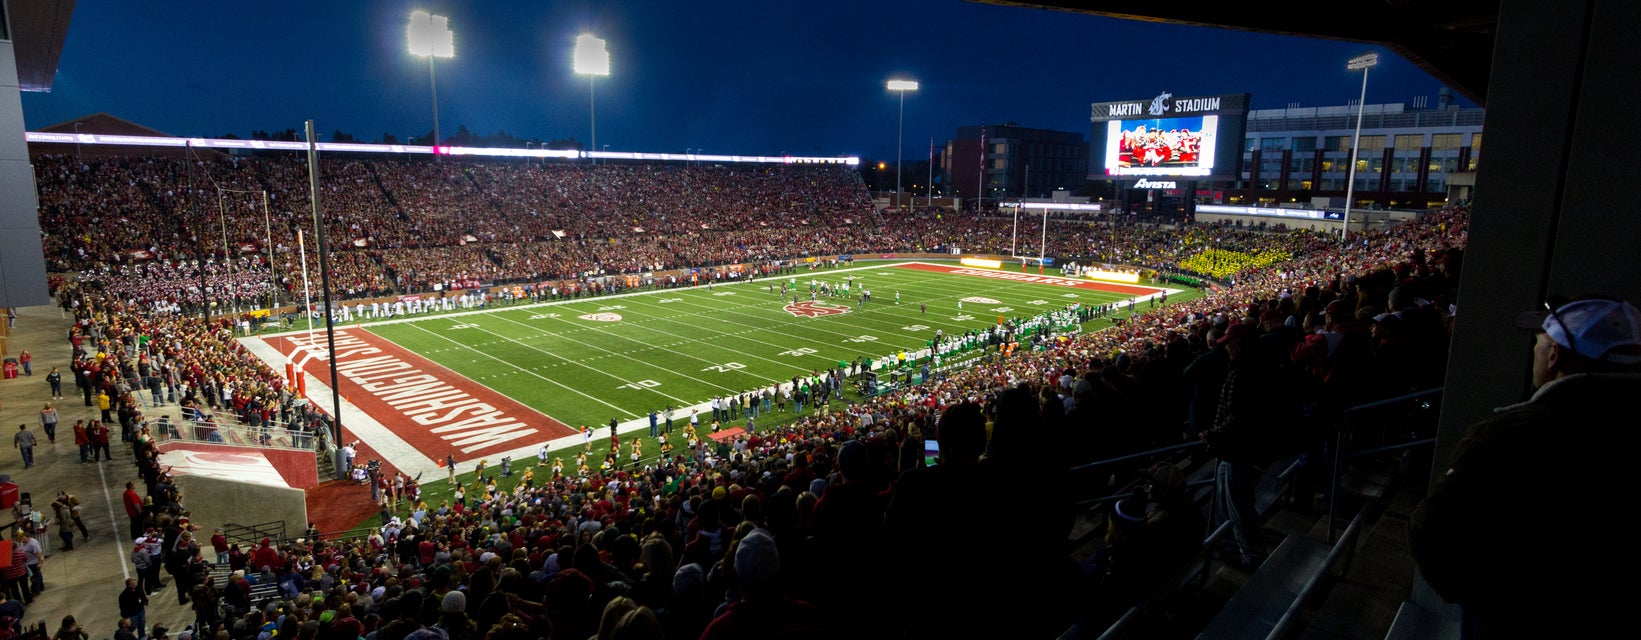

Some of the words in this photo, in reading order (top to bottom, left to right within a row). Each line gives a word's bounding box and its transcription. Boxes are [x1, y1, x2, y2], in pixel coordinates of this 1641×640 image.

[1109, 103, 1142, 116] MARTIN
[1175, 97, 1220, 112] STADIUM
[950, 269, 1084, 286] COUGARS
[711, 362, 747, 373] 20
[626, 379, 662, 390] 10
[328, 355, 539, 454] WASHINGTON
